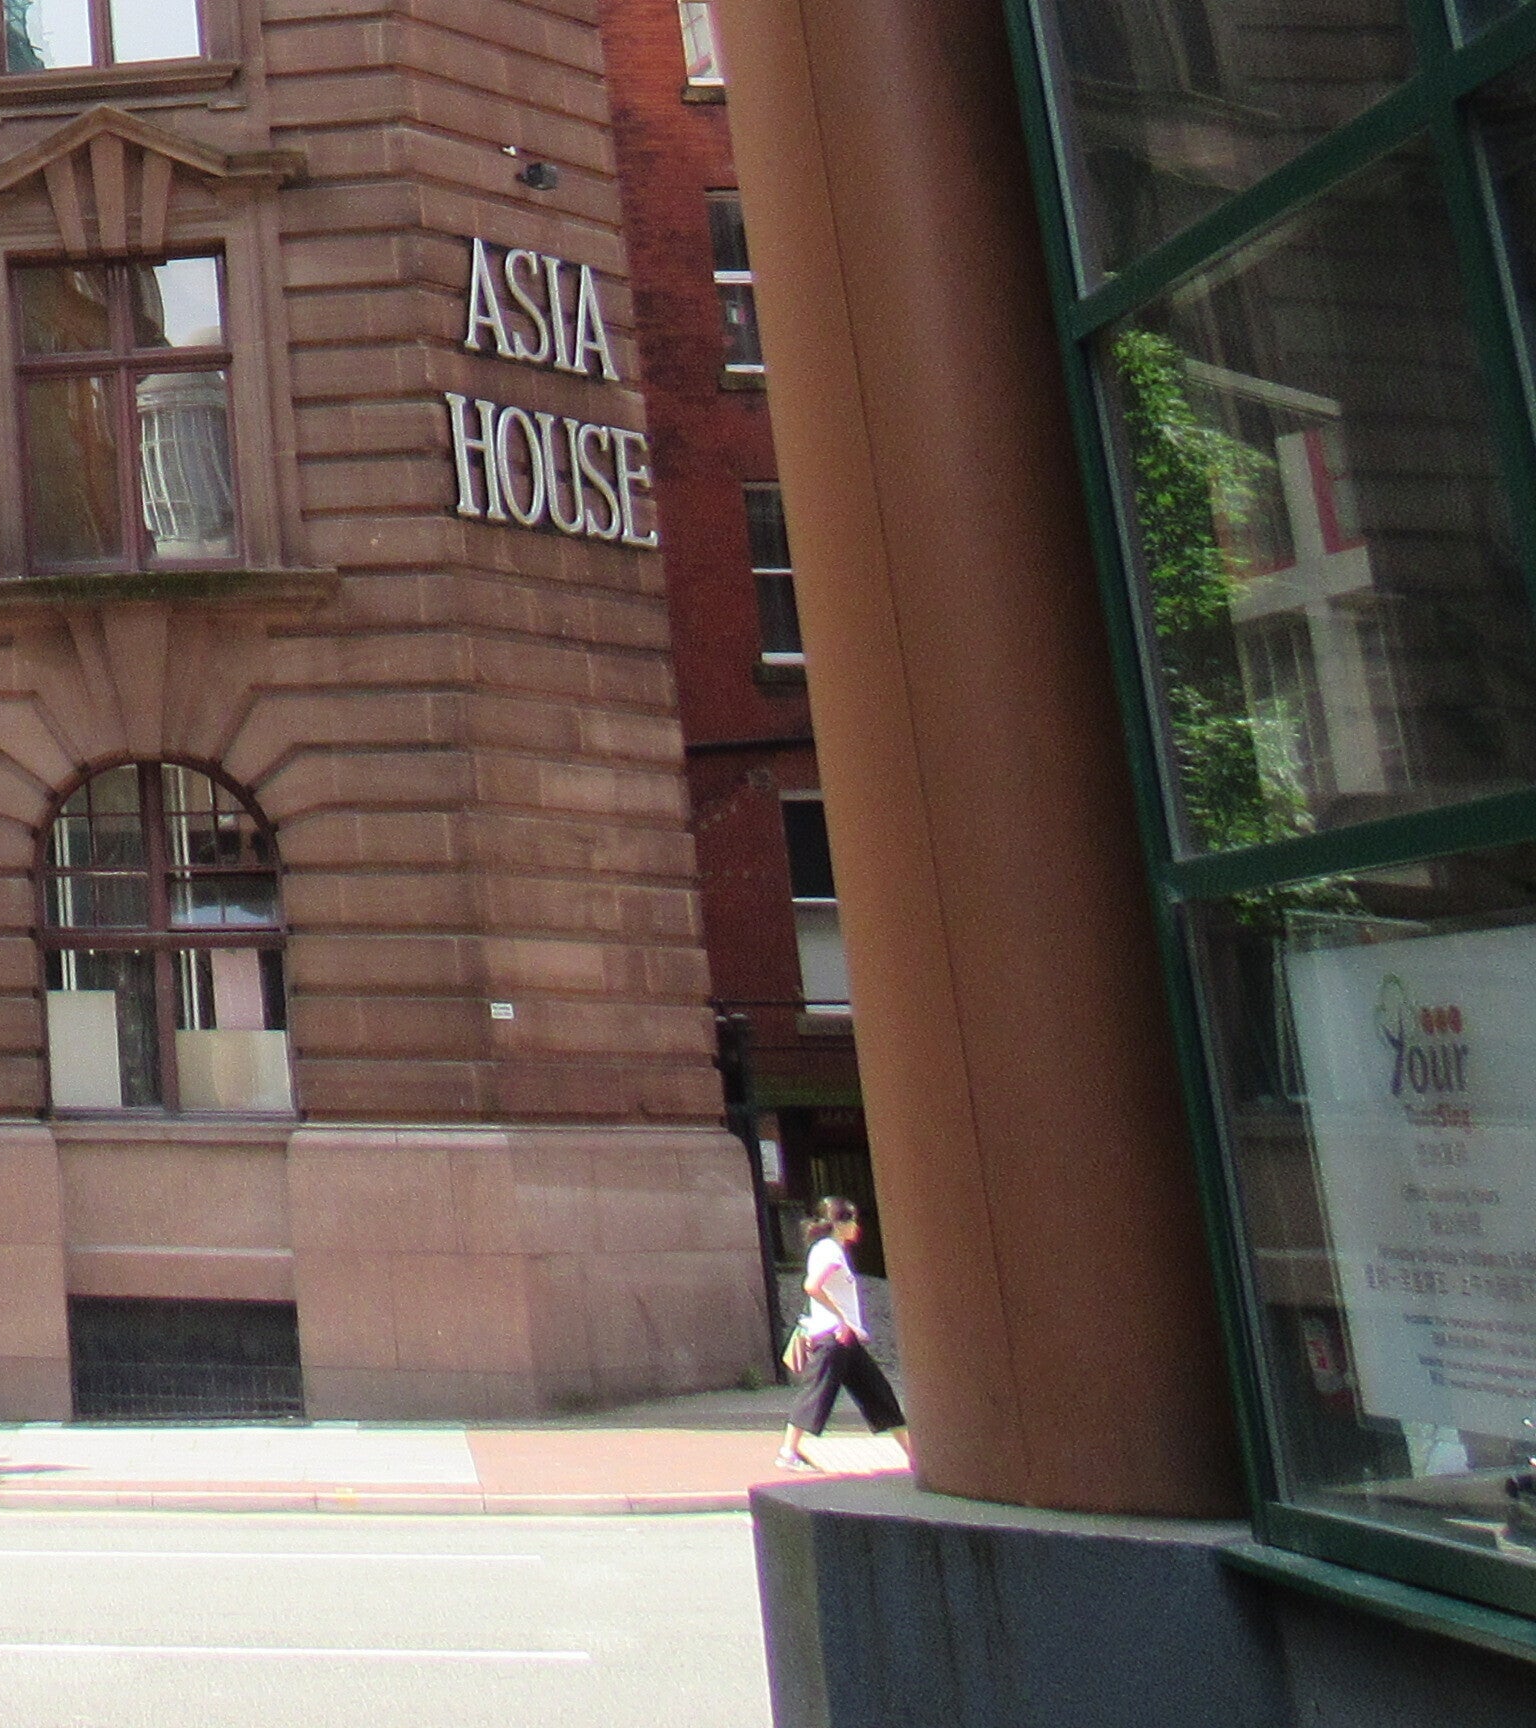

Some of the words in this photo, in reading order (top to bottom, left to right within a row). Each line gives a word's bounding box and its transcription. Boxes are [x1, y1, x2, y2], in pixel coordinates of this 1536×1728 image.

[464, 237, 619, 381] ASIA
[445, 392, 658, 548] HOUSE
[1381, 1010, 1469, 1096] Your
